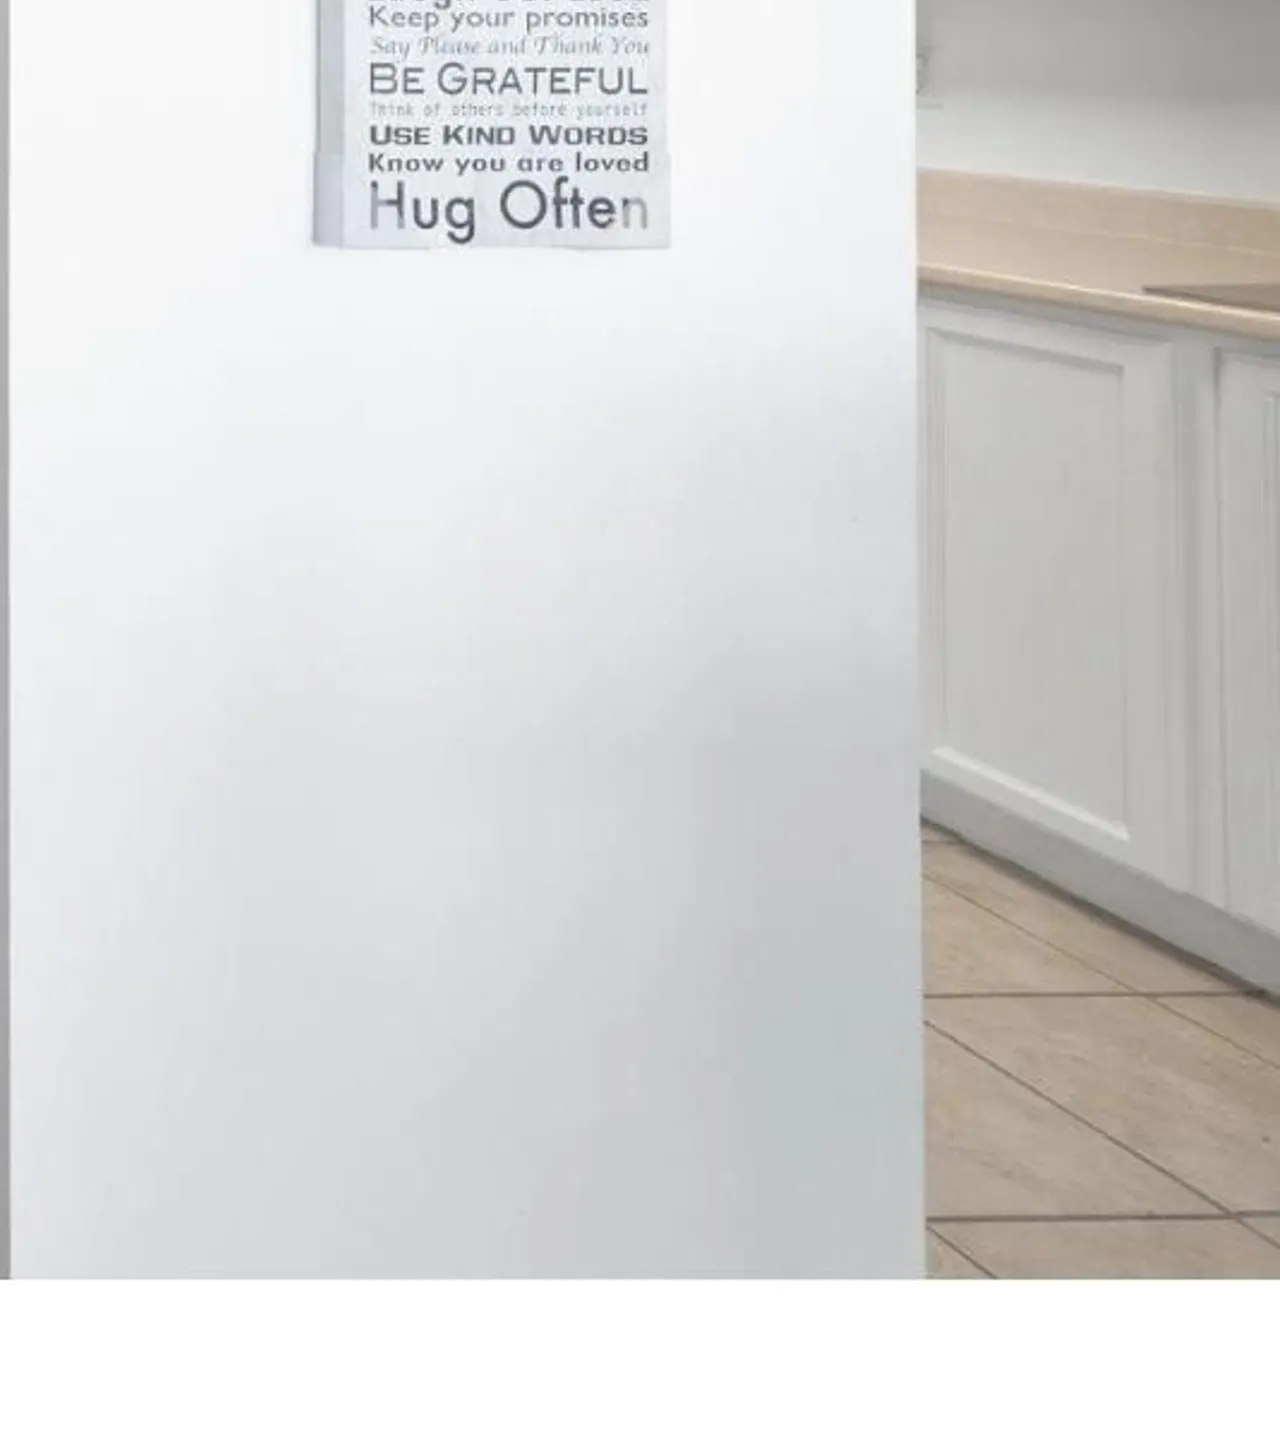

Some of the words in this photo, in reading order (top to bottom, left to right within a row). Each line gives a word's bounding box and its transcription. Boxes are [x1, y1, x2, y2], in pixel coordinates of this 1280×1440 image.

[368, 6, 439, 32] Keep
[451, 11, 515, 33] your
[526, 9, 649, 33] promises
[369, 35, 411, 60] Say
[487, 36, 526, 56] and
[534, 35, 603, 56] Thank
[611, 35, 649, 56] You
[368, 152, 443, 172] Know
[455, 156, 506, 176] you
[517, 157, 564, 173] are
[575, 151, 649, 173] loved
[370, 180, 475, 245] Hug
[499, 175, 648, 230] Often
